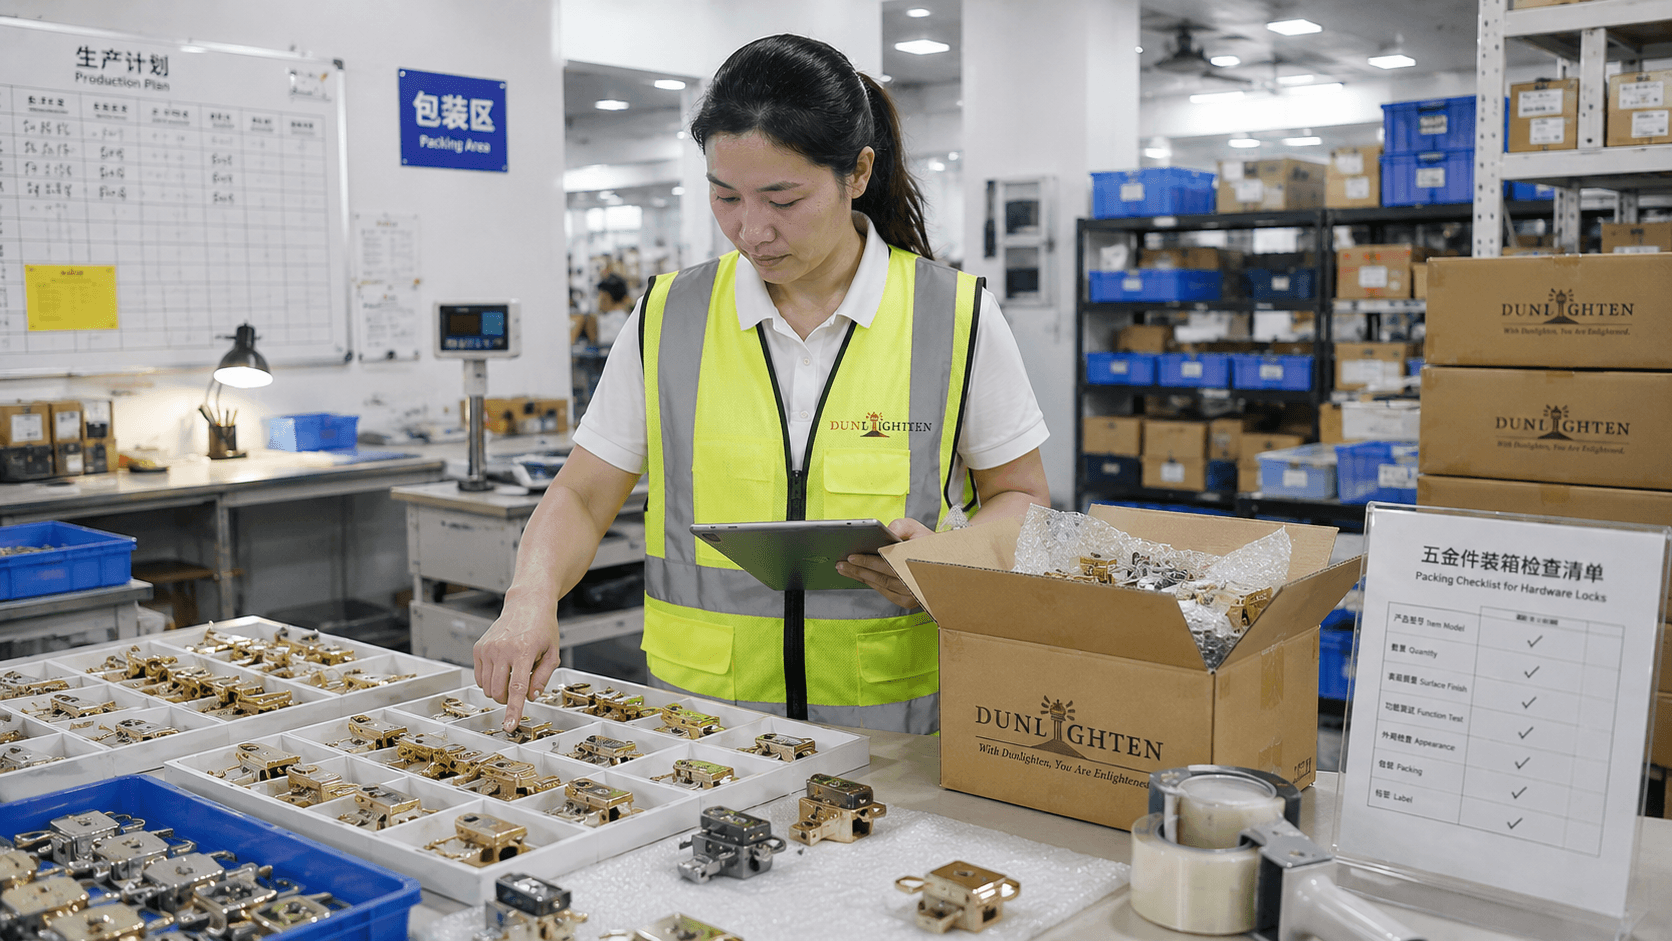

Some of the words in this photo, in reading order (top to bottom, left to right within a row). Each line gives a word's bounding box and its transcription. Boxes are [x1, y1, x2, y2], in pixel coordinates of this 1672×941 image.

[76, 45, 169, 76] 生产计划
[75, 71, 141, 89] Production
[144, 78, 171, 92] Plan
[412, 90, 496, 133] 包装区
[419, 134, 464, 153] Packing
[465, 138, 491, 153] Area
[1421, 546, 1604, 583] 五金件装箱检查清单
[1415, 571, 1454, 586] Packing
[1456, 575, 1501, 590] Checklist
[1503, 581, 1518, 592] for
[1520, 583, 1573, 599] Hardware
[1575, 590, 1607, 603] Locks
[1443, 622, 1465, 632] Model
[1409, 646, 1438, 659] Quantity
[1420, 678, 1446, 689] Surface
[1447, 683, 1468, 693] Finish
[1417, 707, 1446, 720] Function
[1448, 713, 1464, 723] Test
[1414, 738, 1456, 751] Appearance
[979, 743, 1000, 756] With
[1001, 748, 1052, 769] Dunlighten,
[1055, 759, 1073, 773] You
[1074, 765, 1092, 777] Are
[1397, 763, 1423, 777] Packing
[1393, 793, 1413, 804] Label
